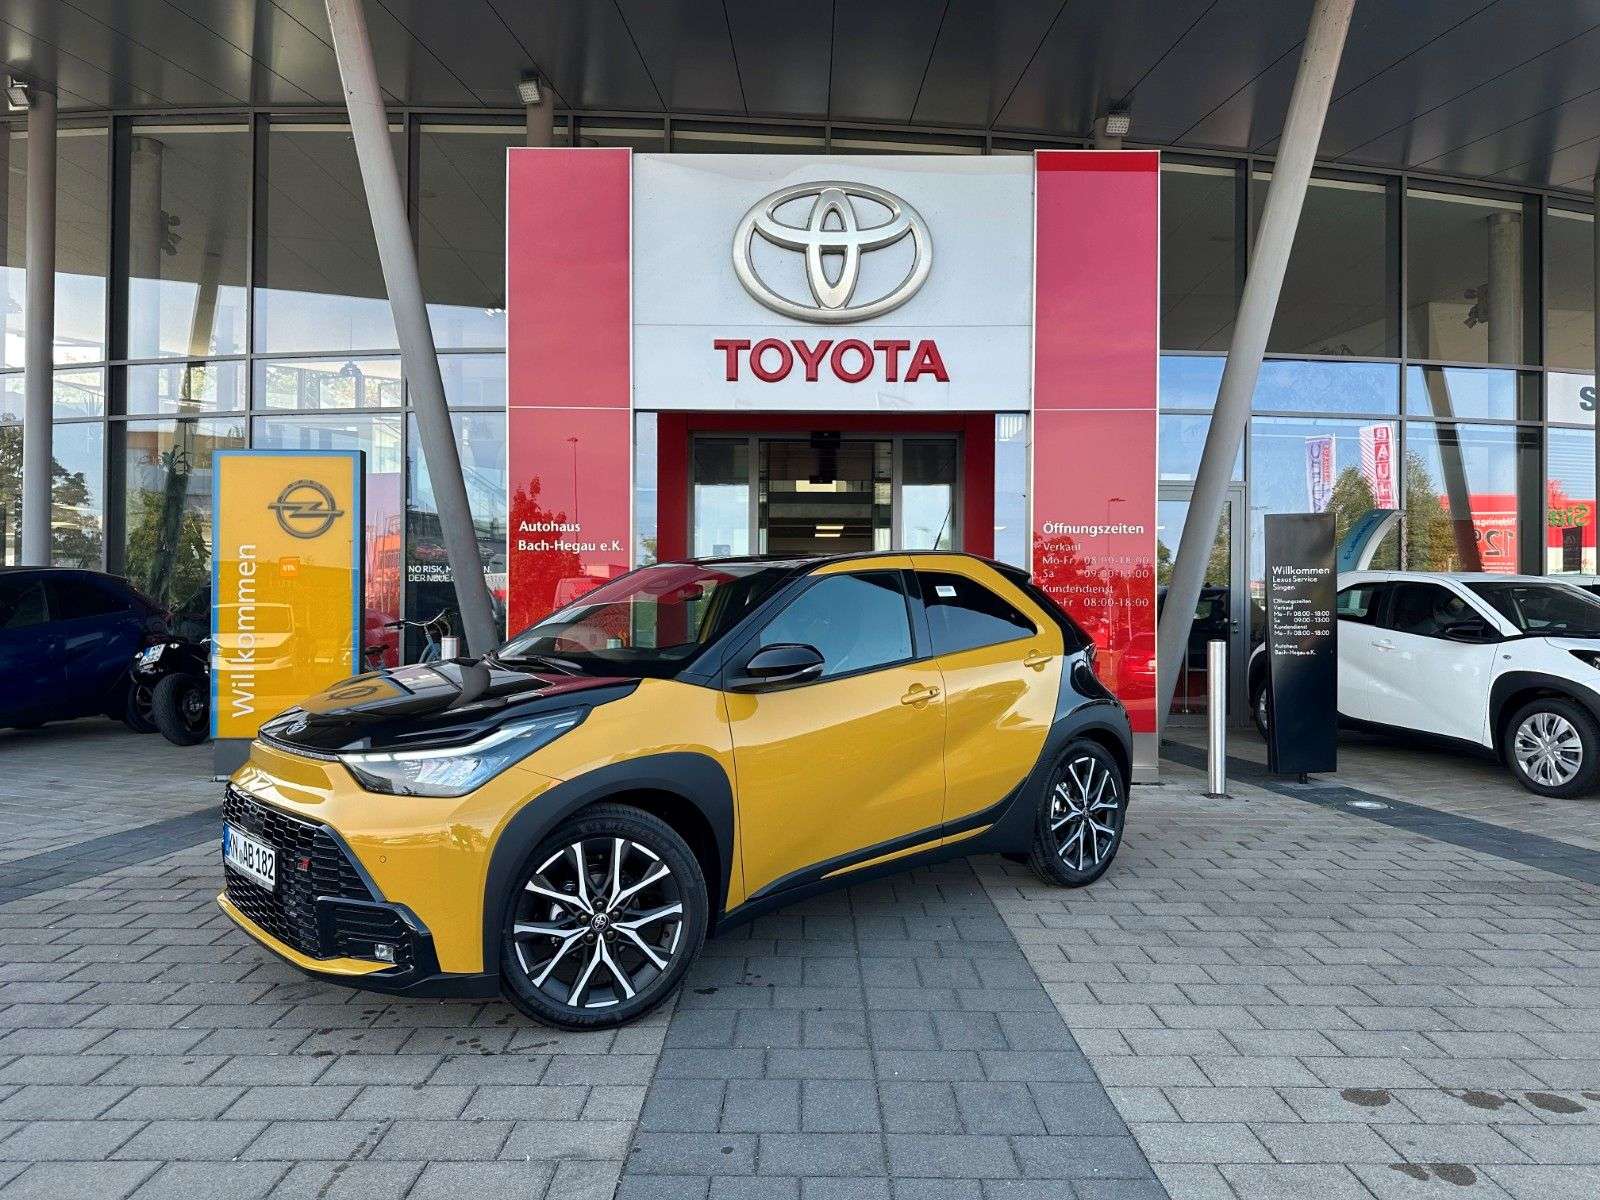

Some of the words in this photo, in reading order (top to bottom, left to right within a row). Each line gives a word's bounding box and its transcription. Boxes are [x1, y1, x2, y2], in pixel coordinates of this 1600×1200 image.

[713, 338, 950, 384] TOYOTA
[519, 520, 581, 532] Autohaus
[1043, 520, 1144, 537] Öffnungszeiten
[518, 540, 596, 554] Bach-Hegau
[600, 540, 624, 551] e.K.
[1043, 543, 1081, 551] Verkauf
[1042, 556, 1073, 564] Mo-Fr
[408, 565, 422, 573] NO
[423, 565, 445, 574] RISK,
[1043, 569, 1055, 578] Sa
[1271, 566, 1330, 575] Willkommen
[408, 574, 426, 582] DER
[1292, 575, 1318, 583] Service
[1042, 585, 1113, 593] Kundendienst
[1083, 598, 1149, 607] 08:00-18:00
[231, 543, 257, 718] Willkommen
[243, 841, 254, 869] AB
[255, 847, 274, 880] 182
